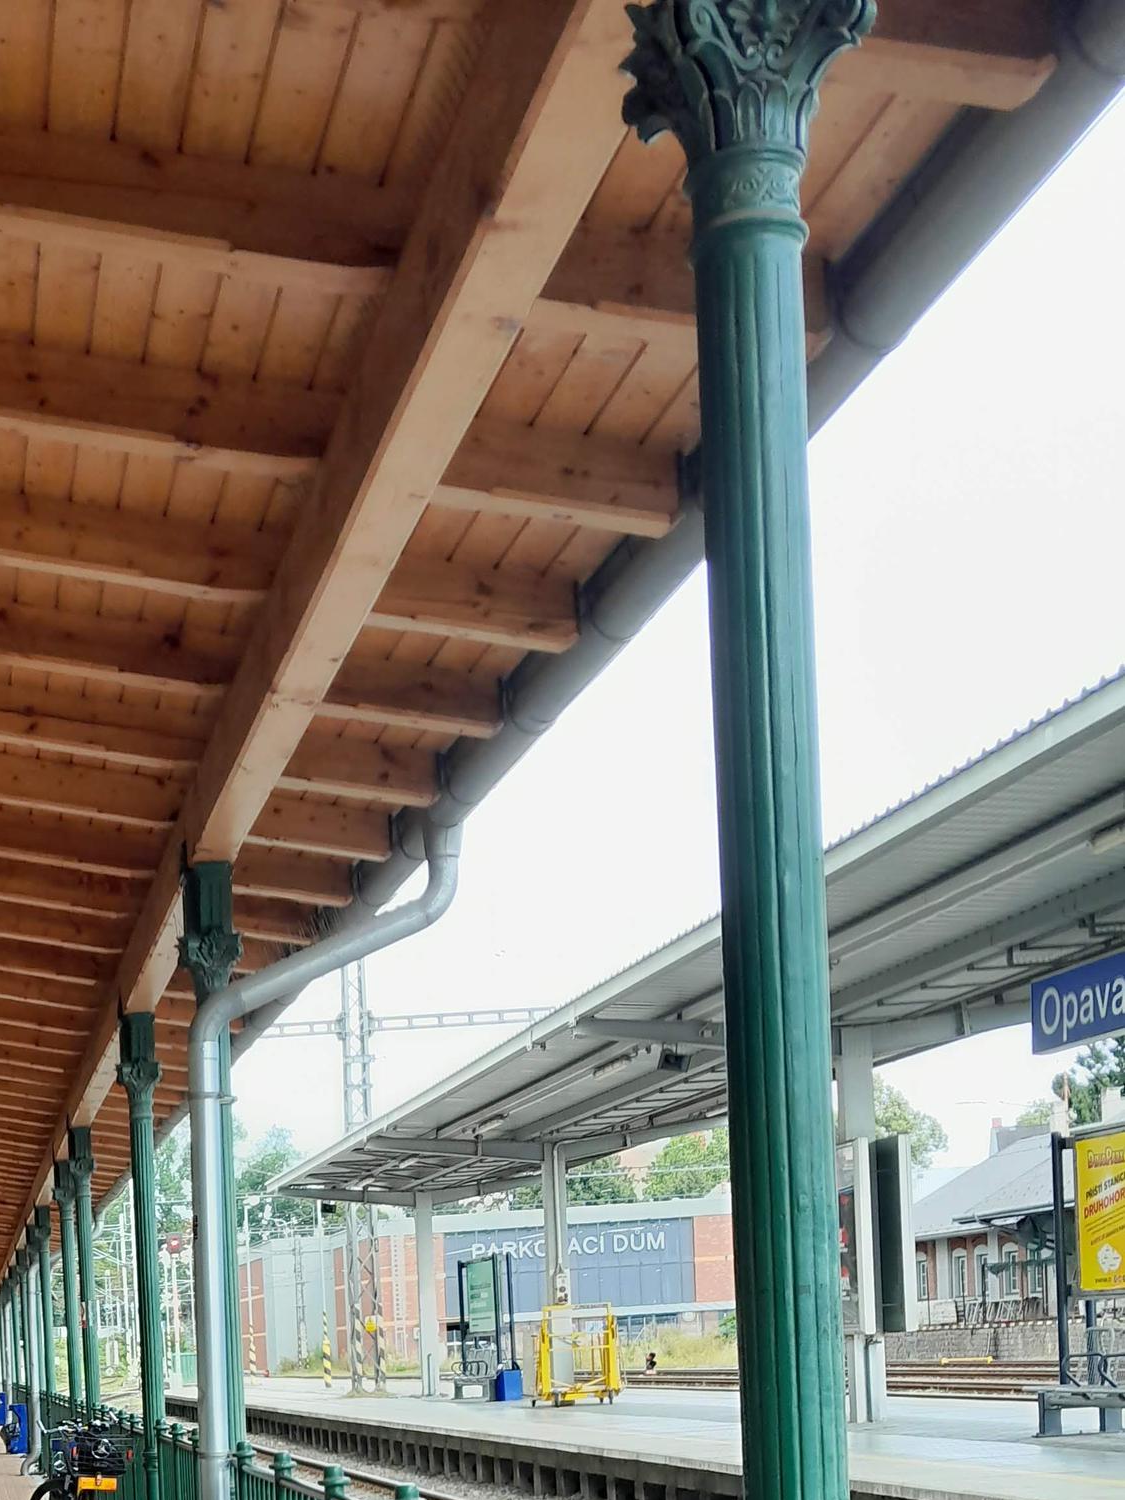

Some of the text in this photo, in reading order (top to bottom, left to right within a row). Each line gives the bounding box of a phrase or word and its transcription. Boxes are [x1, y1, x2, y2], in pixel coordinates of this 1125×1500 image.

[1040, 974, 1125, 1042] Opava
[471, 1229, 666, 1259] PARKOACÍ DŮM
